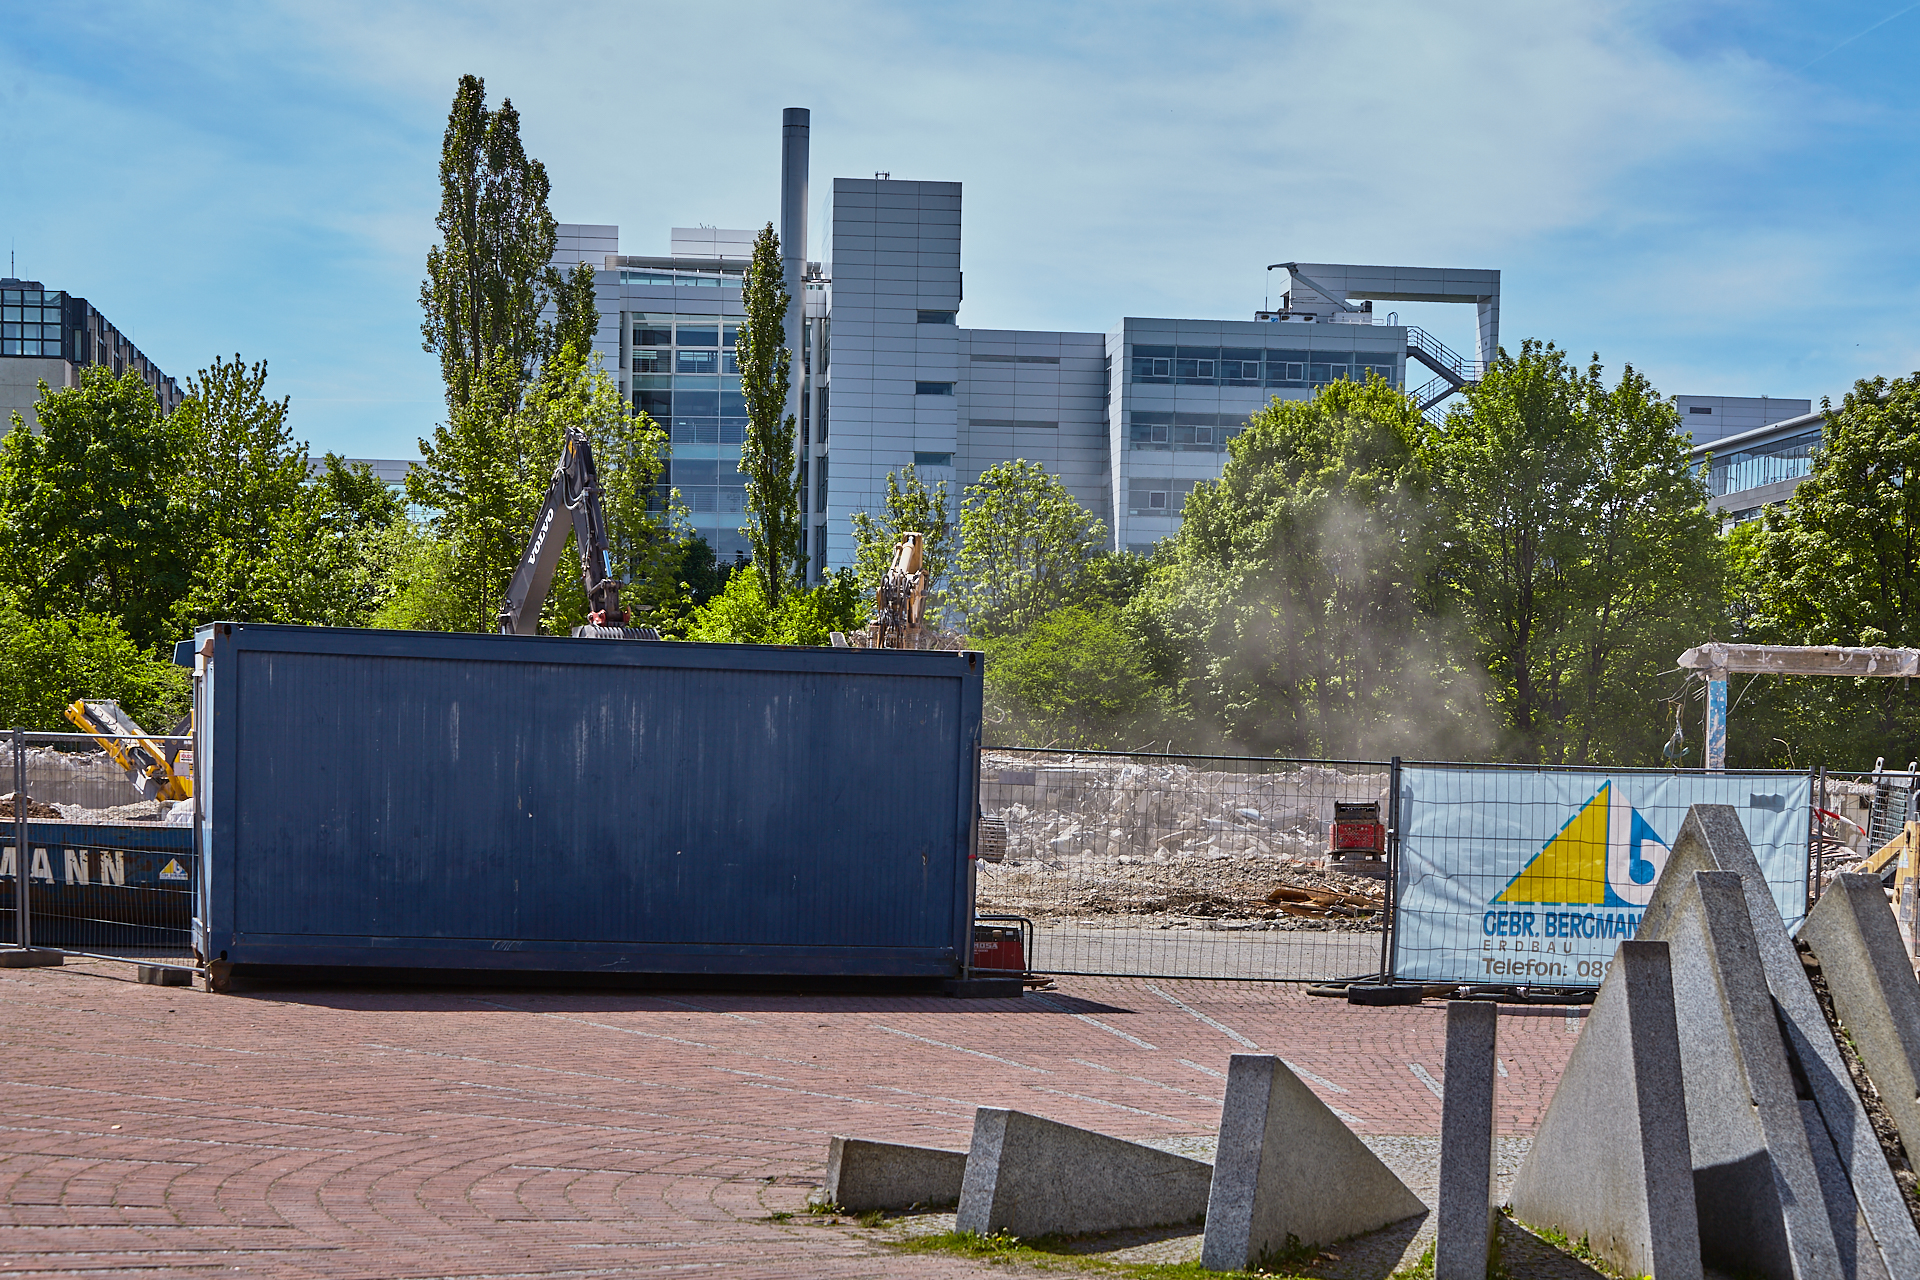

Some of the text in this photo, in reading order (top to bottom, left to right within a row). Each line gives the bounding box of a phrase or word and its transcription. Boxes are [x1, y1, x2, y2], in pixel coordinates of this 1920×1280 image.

[528, 508, 554, 565] VOLVO
[1483, 910, 1540, 938] GEBR.
[1483, 939, 1572, 954] ERDBAU
[1482, 957, 1568, 977] Telefon:
